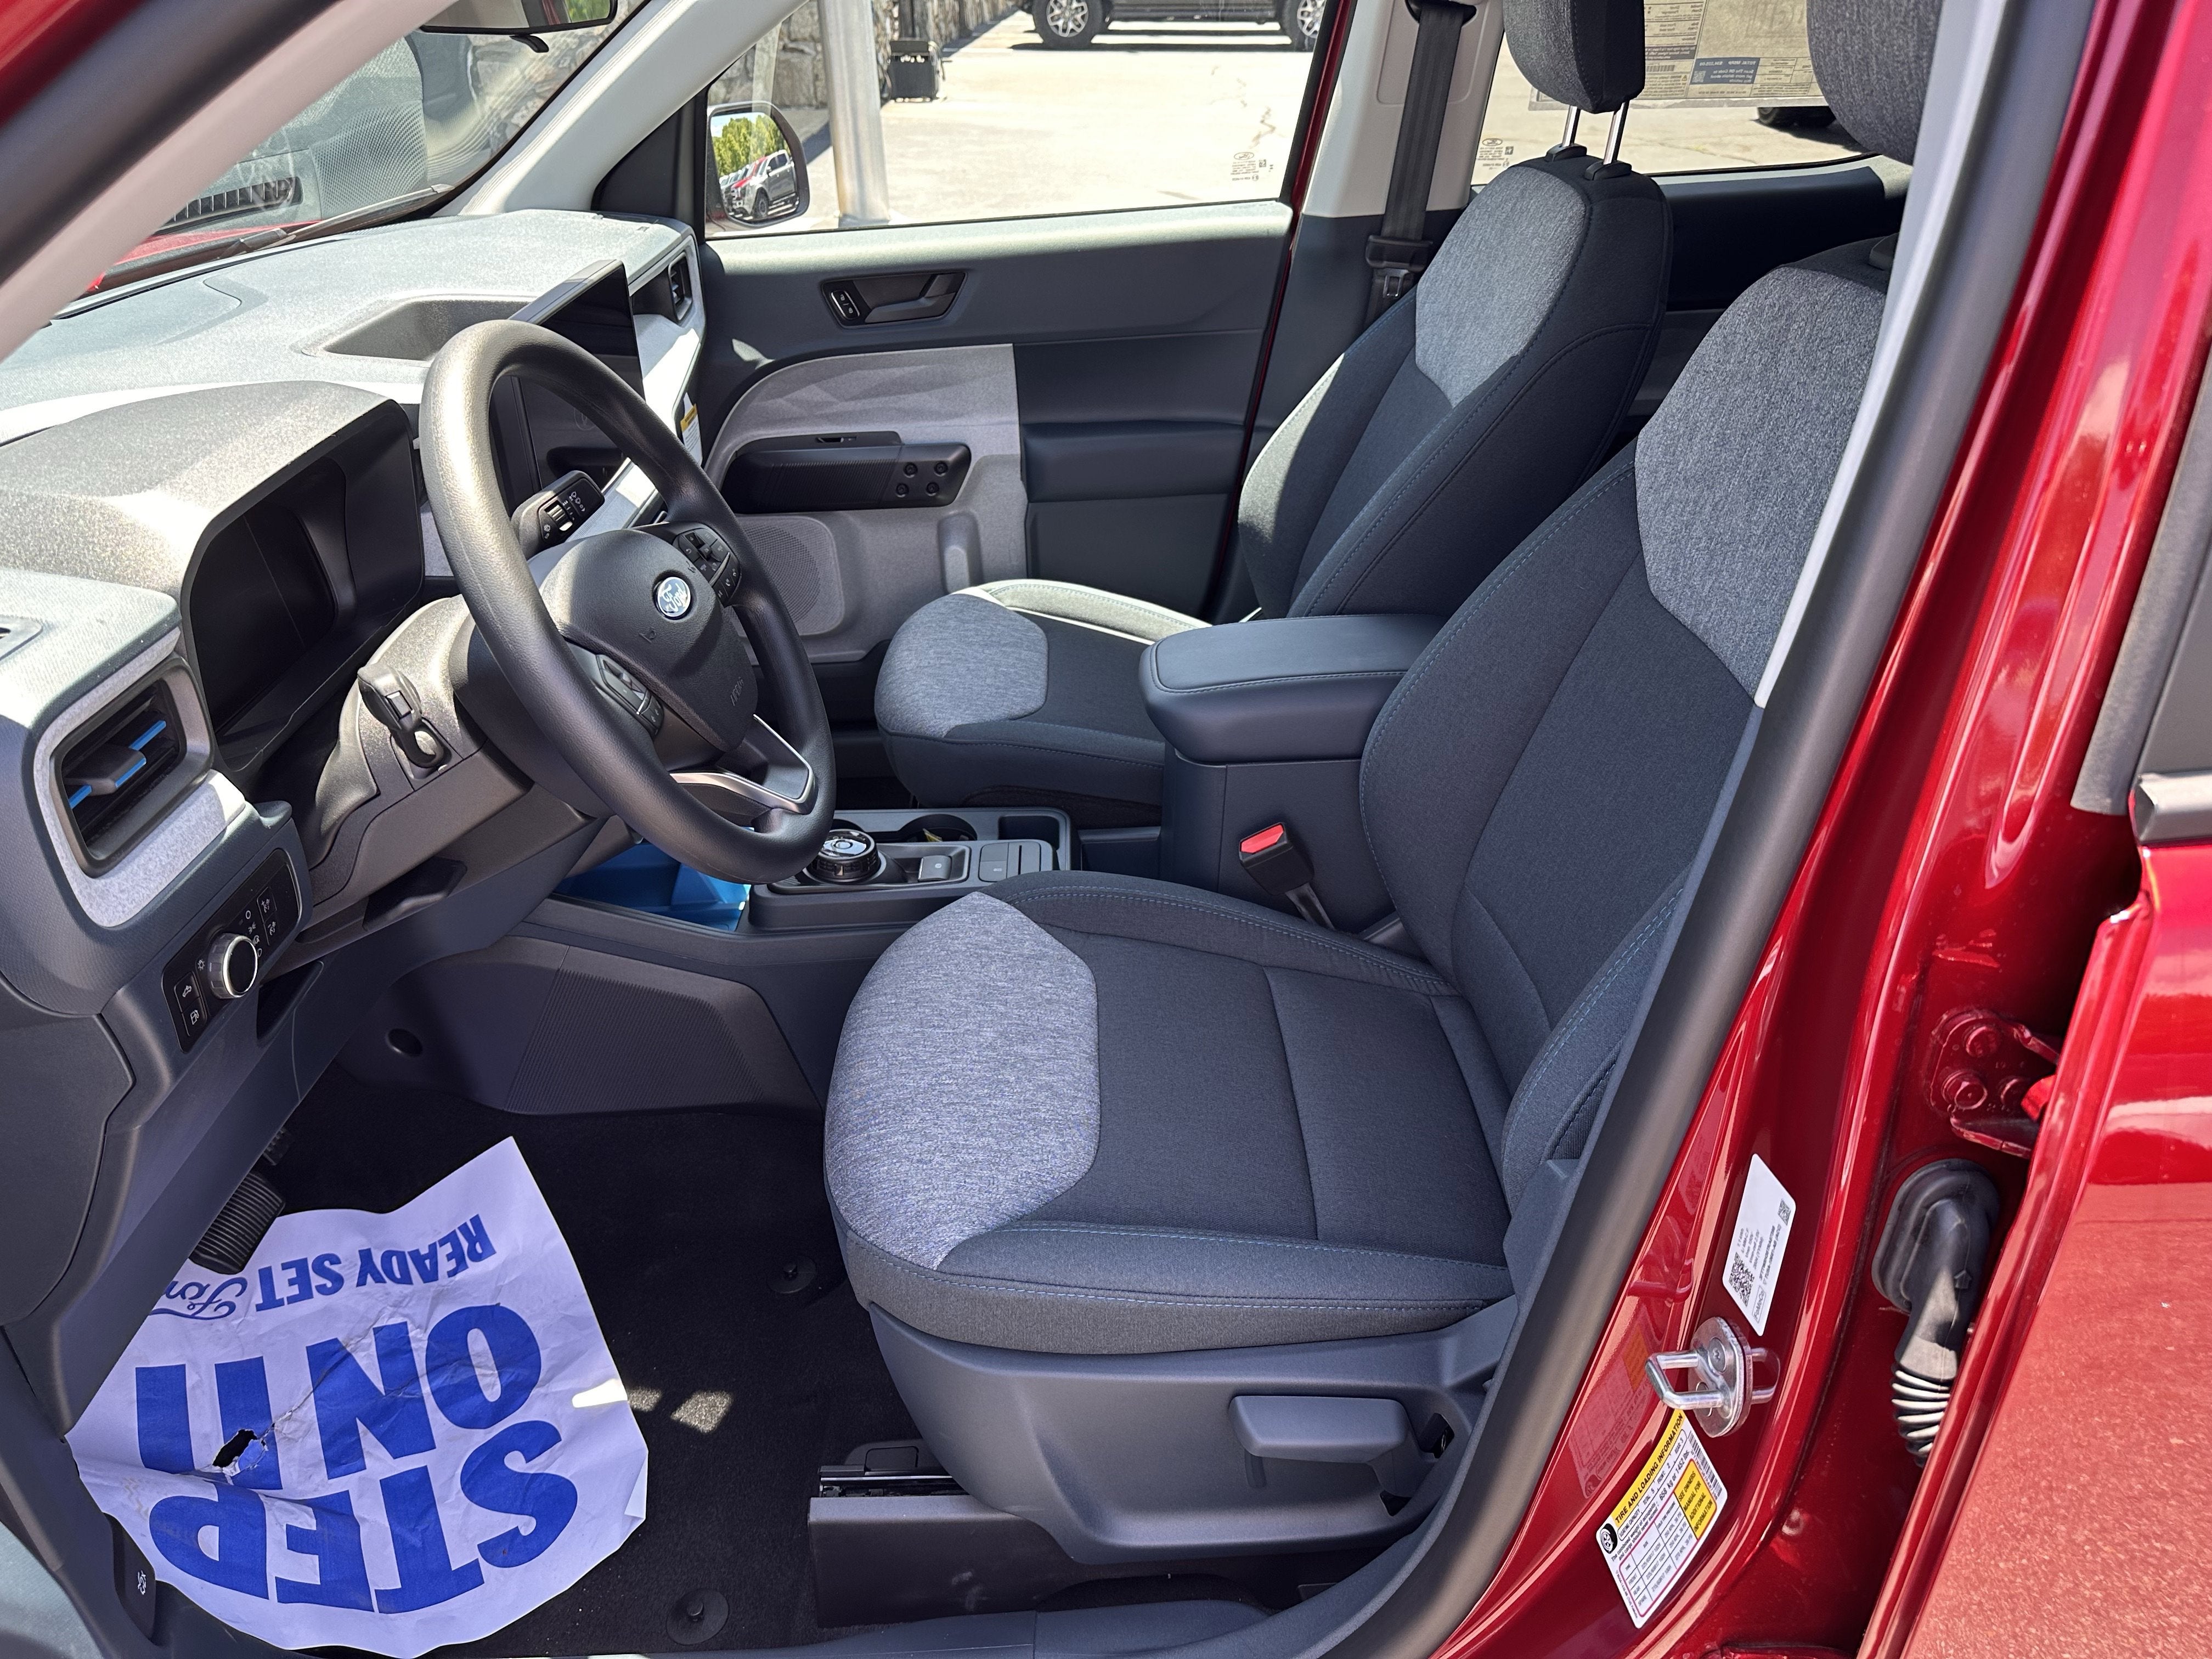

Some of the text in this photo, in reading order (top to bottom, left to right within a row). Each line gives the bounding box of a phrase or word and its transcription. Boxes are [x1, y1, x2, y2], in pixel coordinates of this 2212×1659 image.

[149, 1214, 497, 1321] READY SET For
[306, 1304, 543, 1480] ON
[1615, 1412, 1684, 1526] TIRE AND LOADING INFORMATION
[1650, 1486, 1655, 1494] 5
[1666, 1461, 1671, 1469] 2
[1658, 1486, 1668, 1502] 658
[1666, 1477, 1674, 1491] kg
[1671, 1472, 1677, 1482] or
[1674, 1457, 1685, 1475] 1452
[1677, 1469, 1697, 1502] SEE OWNERS
[1682, 1479, 1702, 1513] MANUAL FOR
[1688, 1491, 1707, 1522] ADDITIONAL
[1692, 1498, 1714, 1533] INFORMATION
[148, 1419, 578, 1614] STEP
